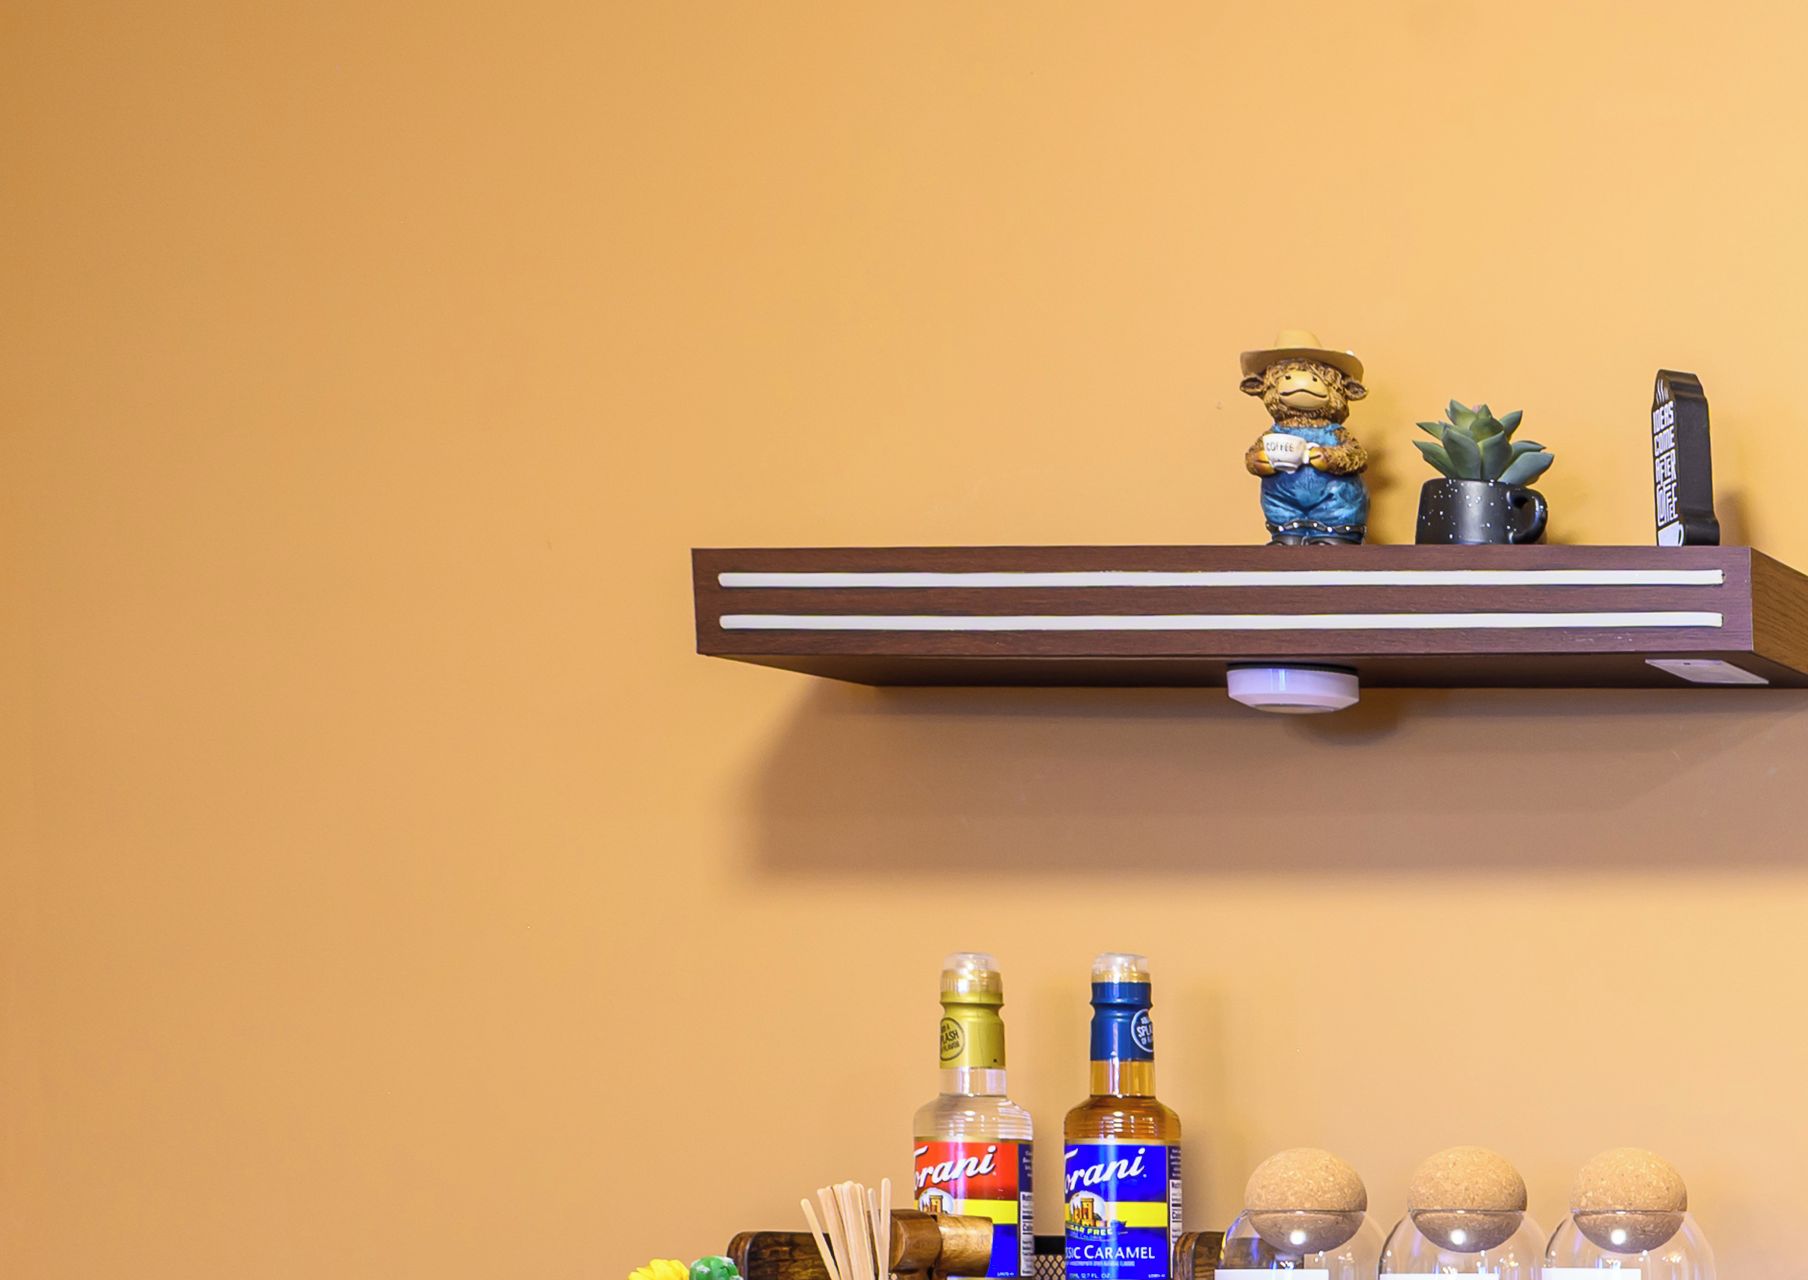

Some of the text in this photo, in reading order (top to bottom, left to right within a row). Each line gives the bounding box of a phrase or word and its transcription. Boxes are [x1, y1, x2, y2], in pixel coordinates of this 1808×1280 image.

[1653, 401, 1674, 433] IDEAS
[1654, 425, 1675, 457] COME
[1655, 449, 1676, 485] AFTER
[1084, 1244, 1155, 1259] CARAMEL
